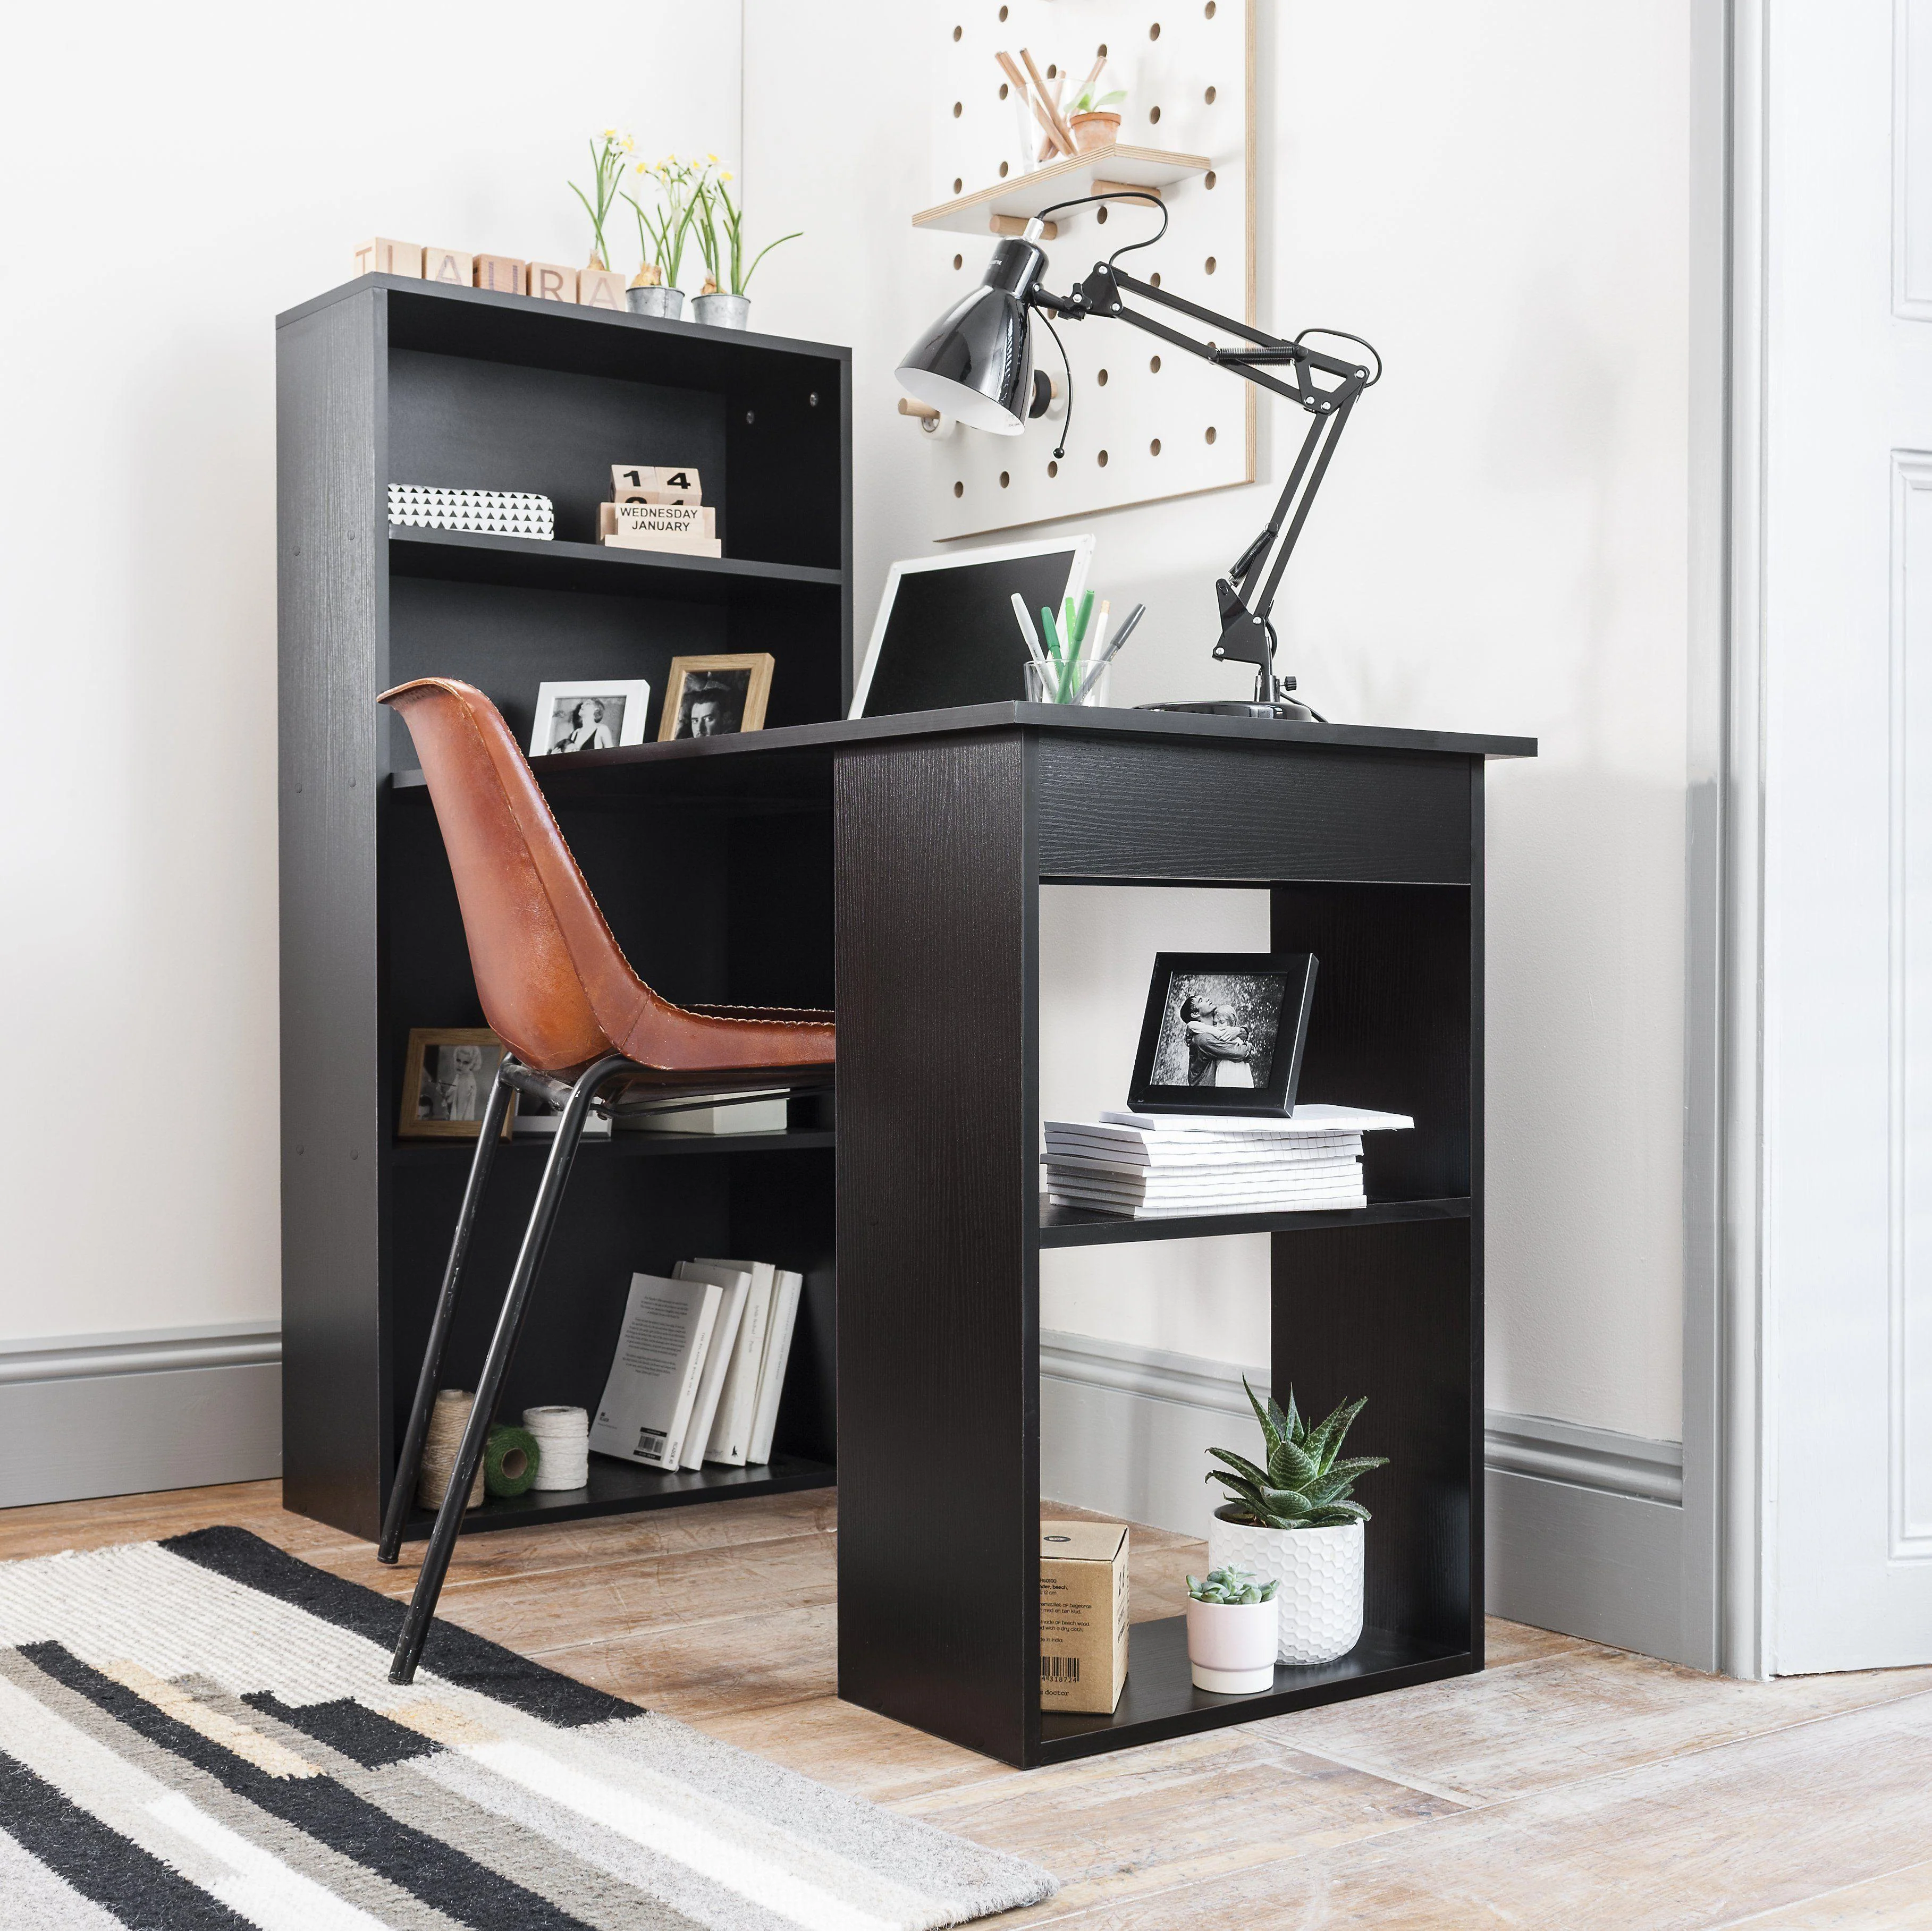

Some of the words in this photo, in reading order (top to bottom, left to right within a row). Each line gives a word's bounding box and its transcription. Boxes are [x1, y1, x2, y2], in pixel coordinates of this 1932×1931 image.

[623, 470, 642, 487] 1
[667, 472, 691, 489] 4
[620, 507, 697, 519] WEDNESDAY
[632, 521, 690, 531] JANUARY
